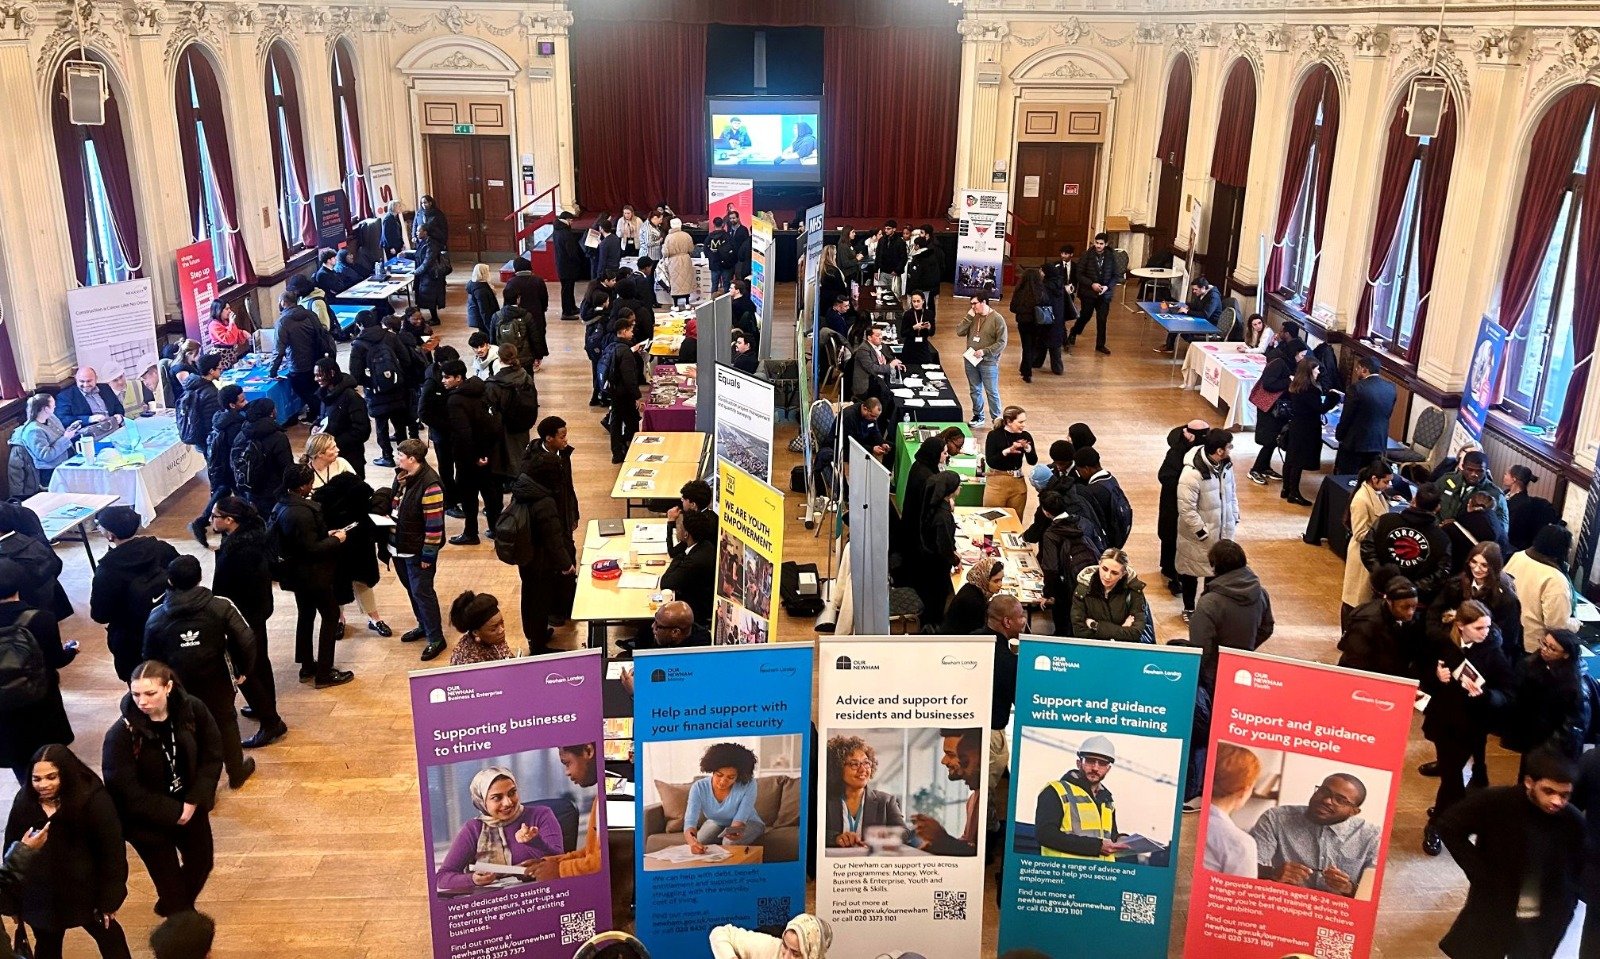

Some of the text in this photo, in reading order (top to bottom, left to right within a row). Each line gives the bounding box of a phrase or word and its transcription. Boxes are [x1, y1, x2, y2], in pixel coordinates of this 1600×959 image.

[810, 216, 822, 233] NHS
[190, 267, 210, 280] Step up
[718, 372, 741, 389] Equals
[725, 499, 770, 537] WE ARE YOUTH
[723, 512, 773, 554] EMPOWERMENT.
[1389, 529, 1427, 549] TORONTO
[652, 701, 787, 719] Help and support with
[836, 695, 968, 707] Advice and support for
[1033, 694, 1166, 714] Support and guidance
[836, 709, 974, 720] residents and businesses
[1032, 709, 1168, 733] with work and training
[434, 714, 577, 741] Supporting businesses
[652, 718, 783, 736] your financial security
[1231, 708, 1375, 744] Support and guidance
[1229, 723, 1341, 753] for young people
[435, 741, 491, 756] to thrive
[1019, 876, 1065, 884] employment.
[1062, 870, 1078, 878] help
[471, 894, 508, 907] dedicated
[520, 887, 550, 897] assisting
[522, 895, 554, 905] start-ups
[556, 890, 569, 898] and
[1211, 876, 1349, 909] We provide residents aged 16-24 with
[832, 907, 928, 915] newham.gov.uk/ournewham
[1018, 897, 1116, 911] newham.gov.uk/ournewham
[1209, 893, 1233, 903] ensure
[1277, 906, 1313, 917] equipped
[1325, 916, 1354, 926] achieve
[449, 918, 483, 929] fostering
[499, 908, 525, 920] growth
[537, 901, 565, 910] existing
[450, 925, 491, 937] businesses.
[1205, 923, 1309, 947] newham.gov.uk/ournewham
[451, 942, 467, 951] Find
[452, 933, 555, 959] newham.gov.uk/ournewham
[493, 946, 525, 959] 3373 7373
